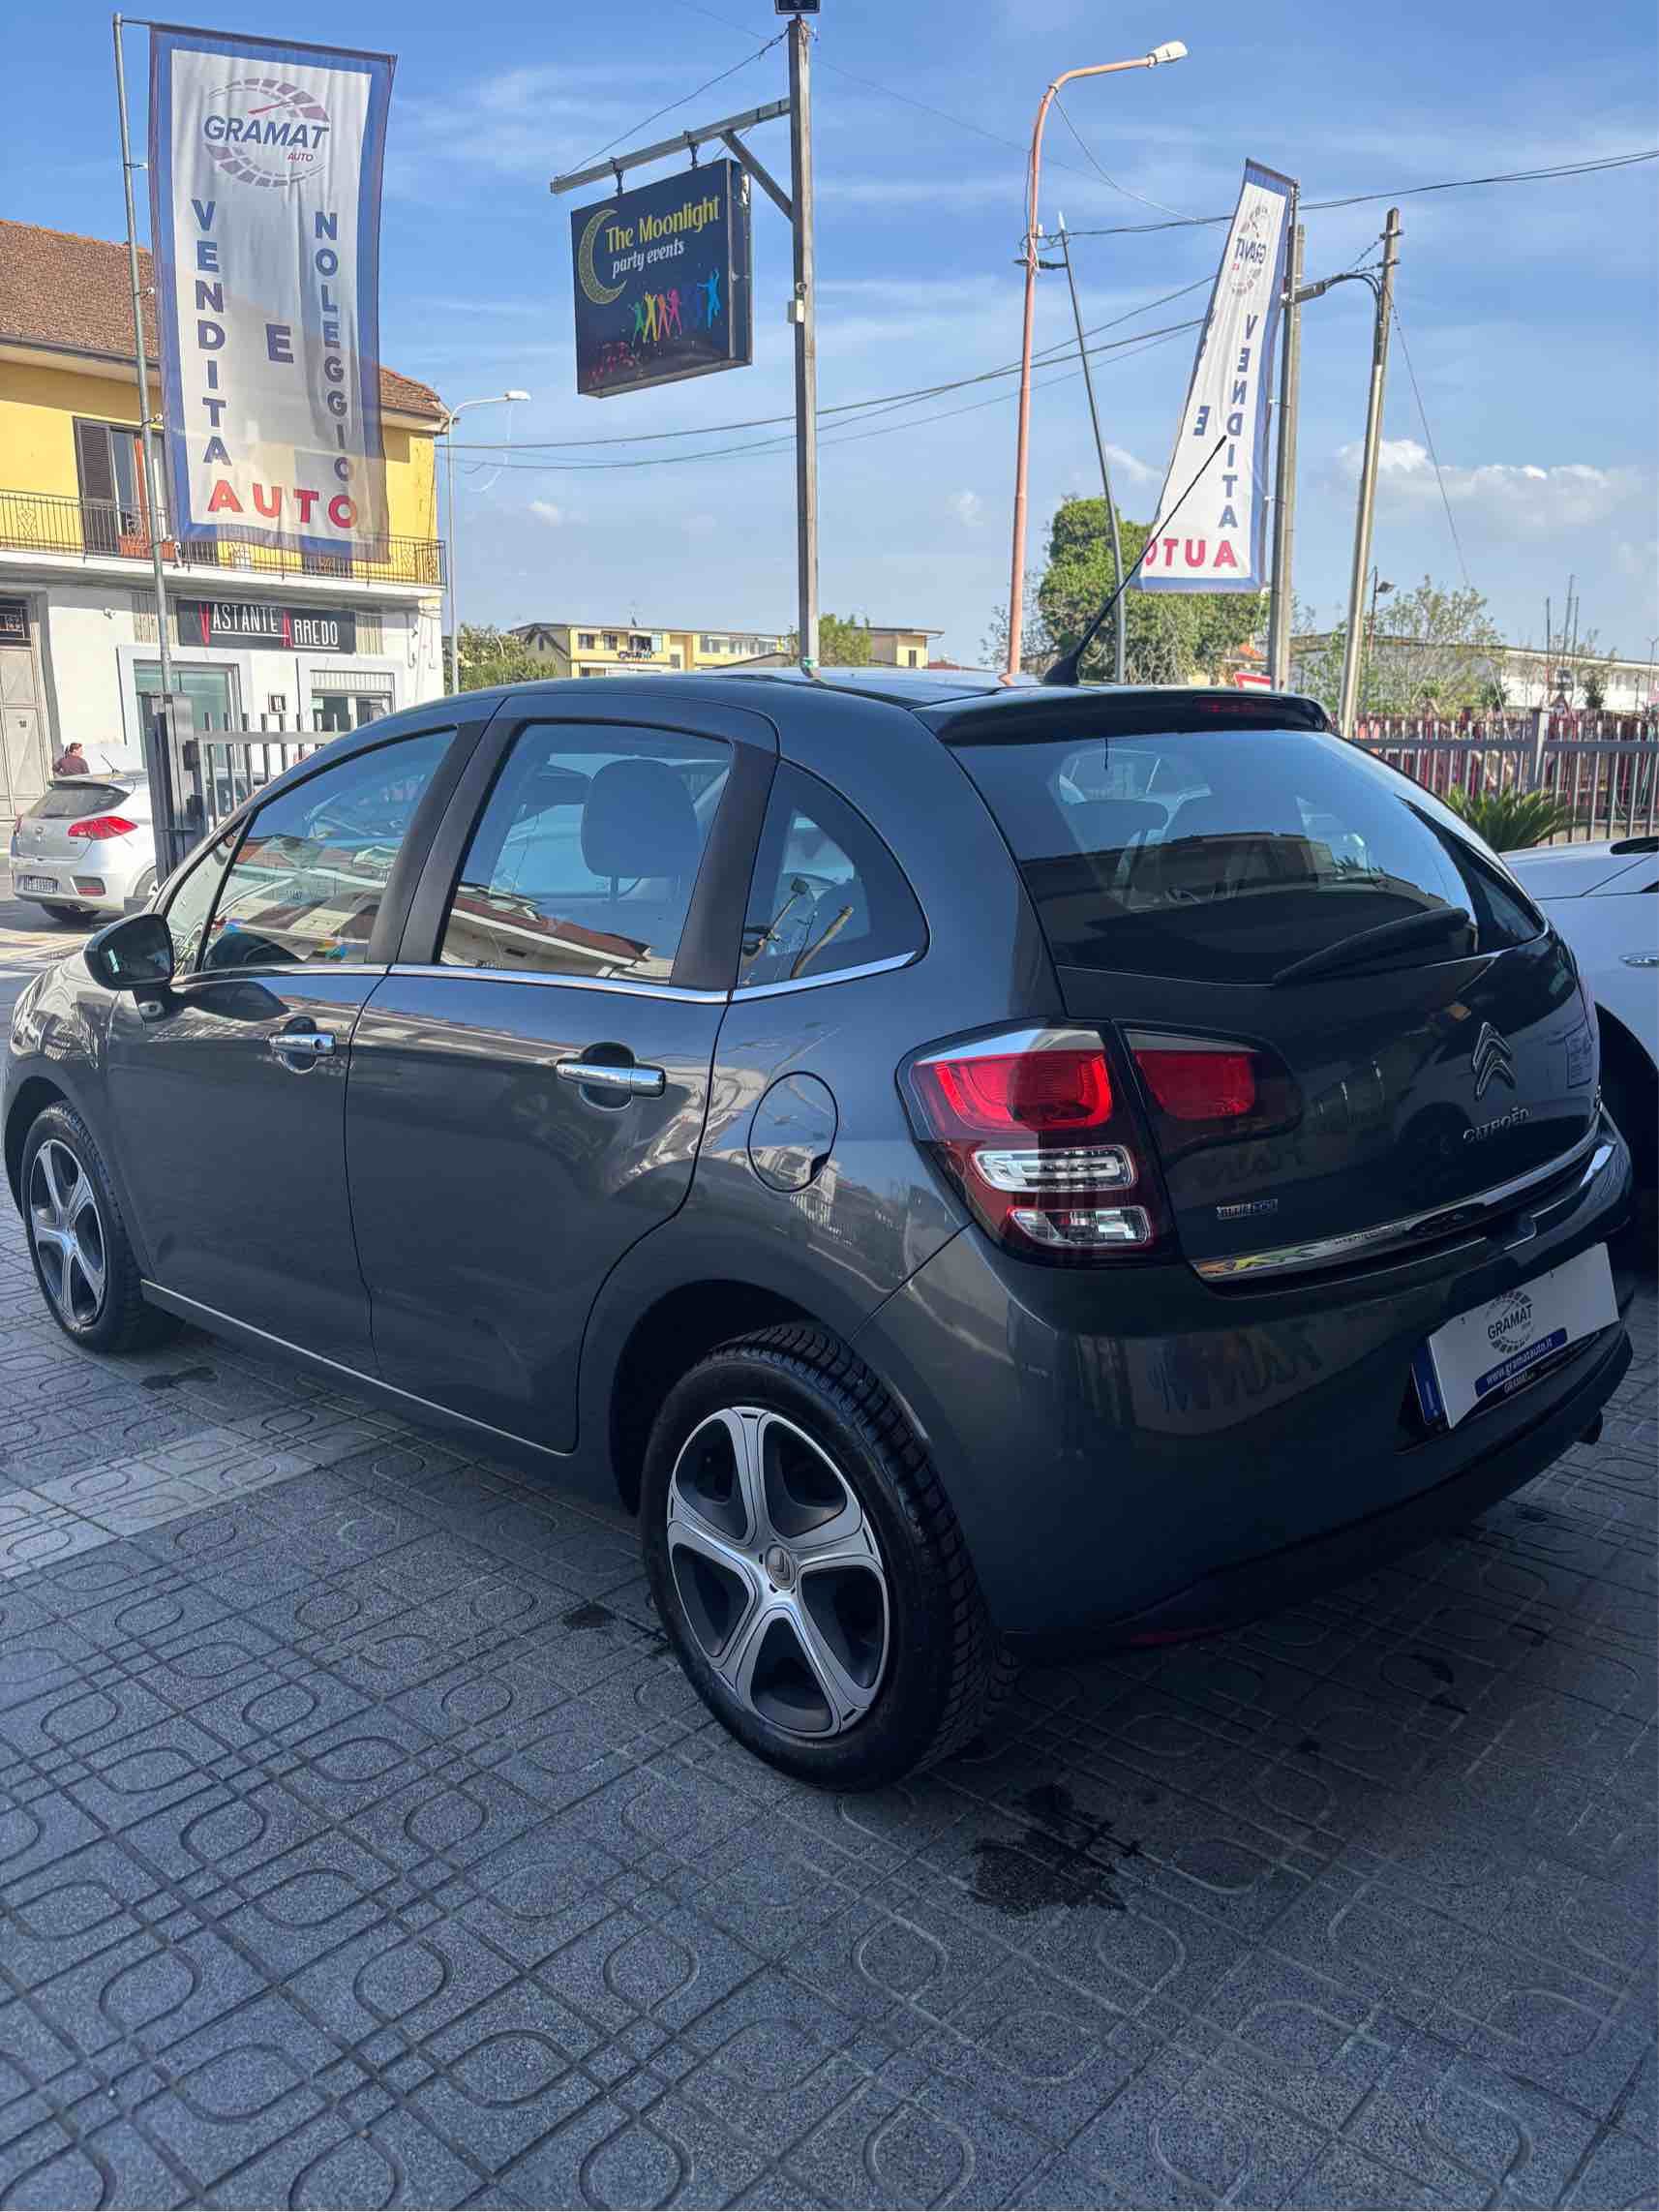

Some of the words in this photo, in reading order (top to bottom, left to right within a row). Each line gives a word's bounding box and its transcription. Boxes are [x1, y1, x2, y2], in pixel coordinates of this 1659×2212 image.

[203, 115, 330, 149] GRAMAT
[287, 152, 314, 162] AUTO
[604, 225, 634, 254] The
[639, 196, 720, 243] Moonlight
[612, 249, 645, 279] party
[647, 239, 684, 263] events
[191, 198, 232, 467] VENDITA
[265, 323, 294, 364] E
[315, 211, 352, 482] NOLEGGIO
[207, 479, 358, 529] AUTO
[198, 603, 279, 646] VASTANTE
[1487, 1304, 1533, 1340] GRAMAT
